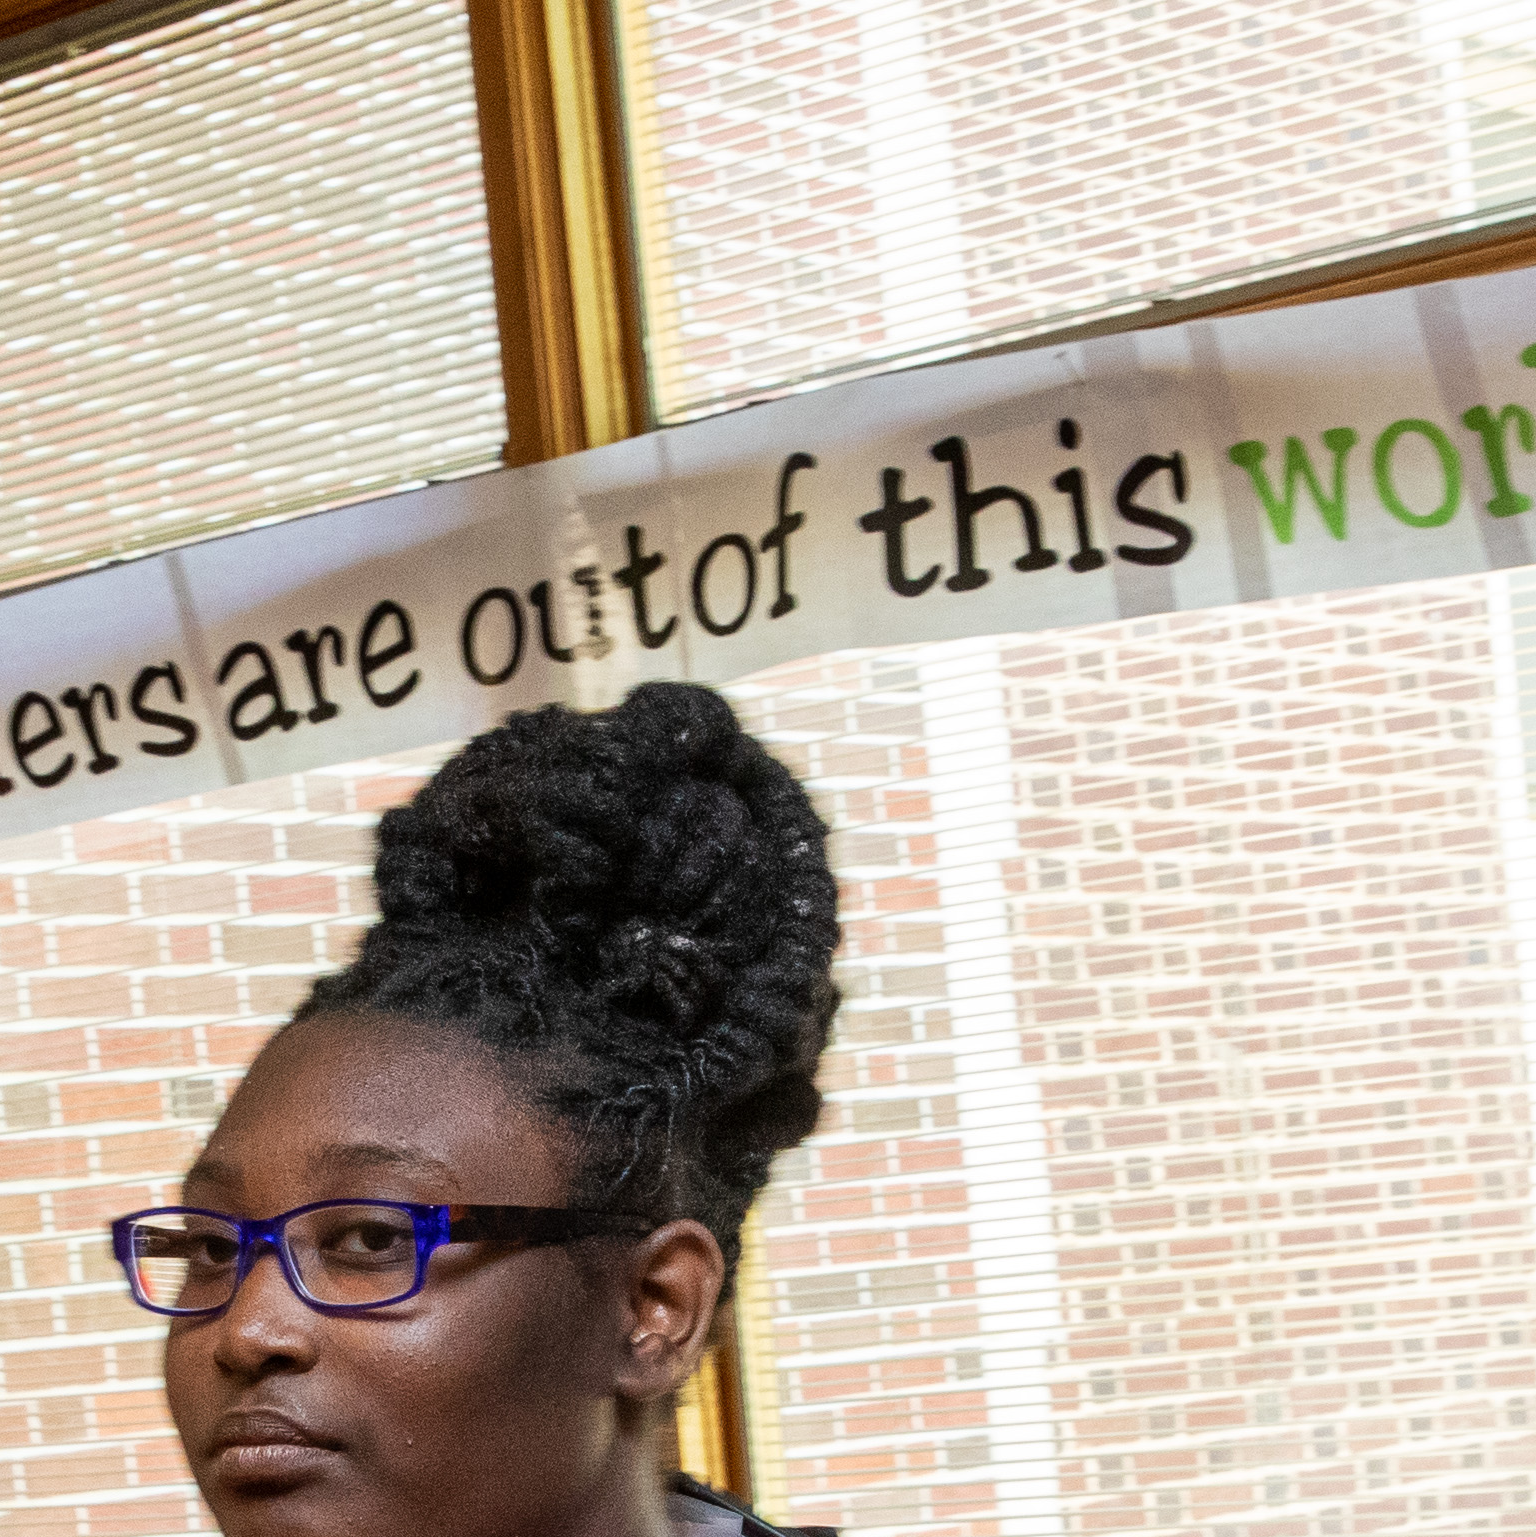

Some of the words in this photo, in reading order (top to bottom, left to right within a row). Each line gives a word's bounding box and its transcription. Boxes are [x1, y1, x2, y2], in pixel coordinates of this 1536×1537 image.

[221, 598, 423, 744] are
[461, 524, 680, 686] out
[687, 452, 819, 634] of
[858, 415, 1195, 598] this
